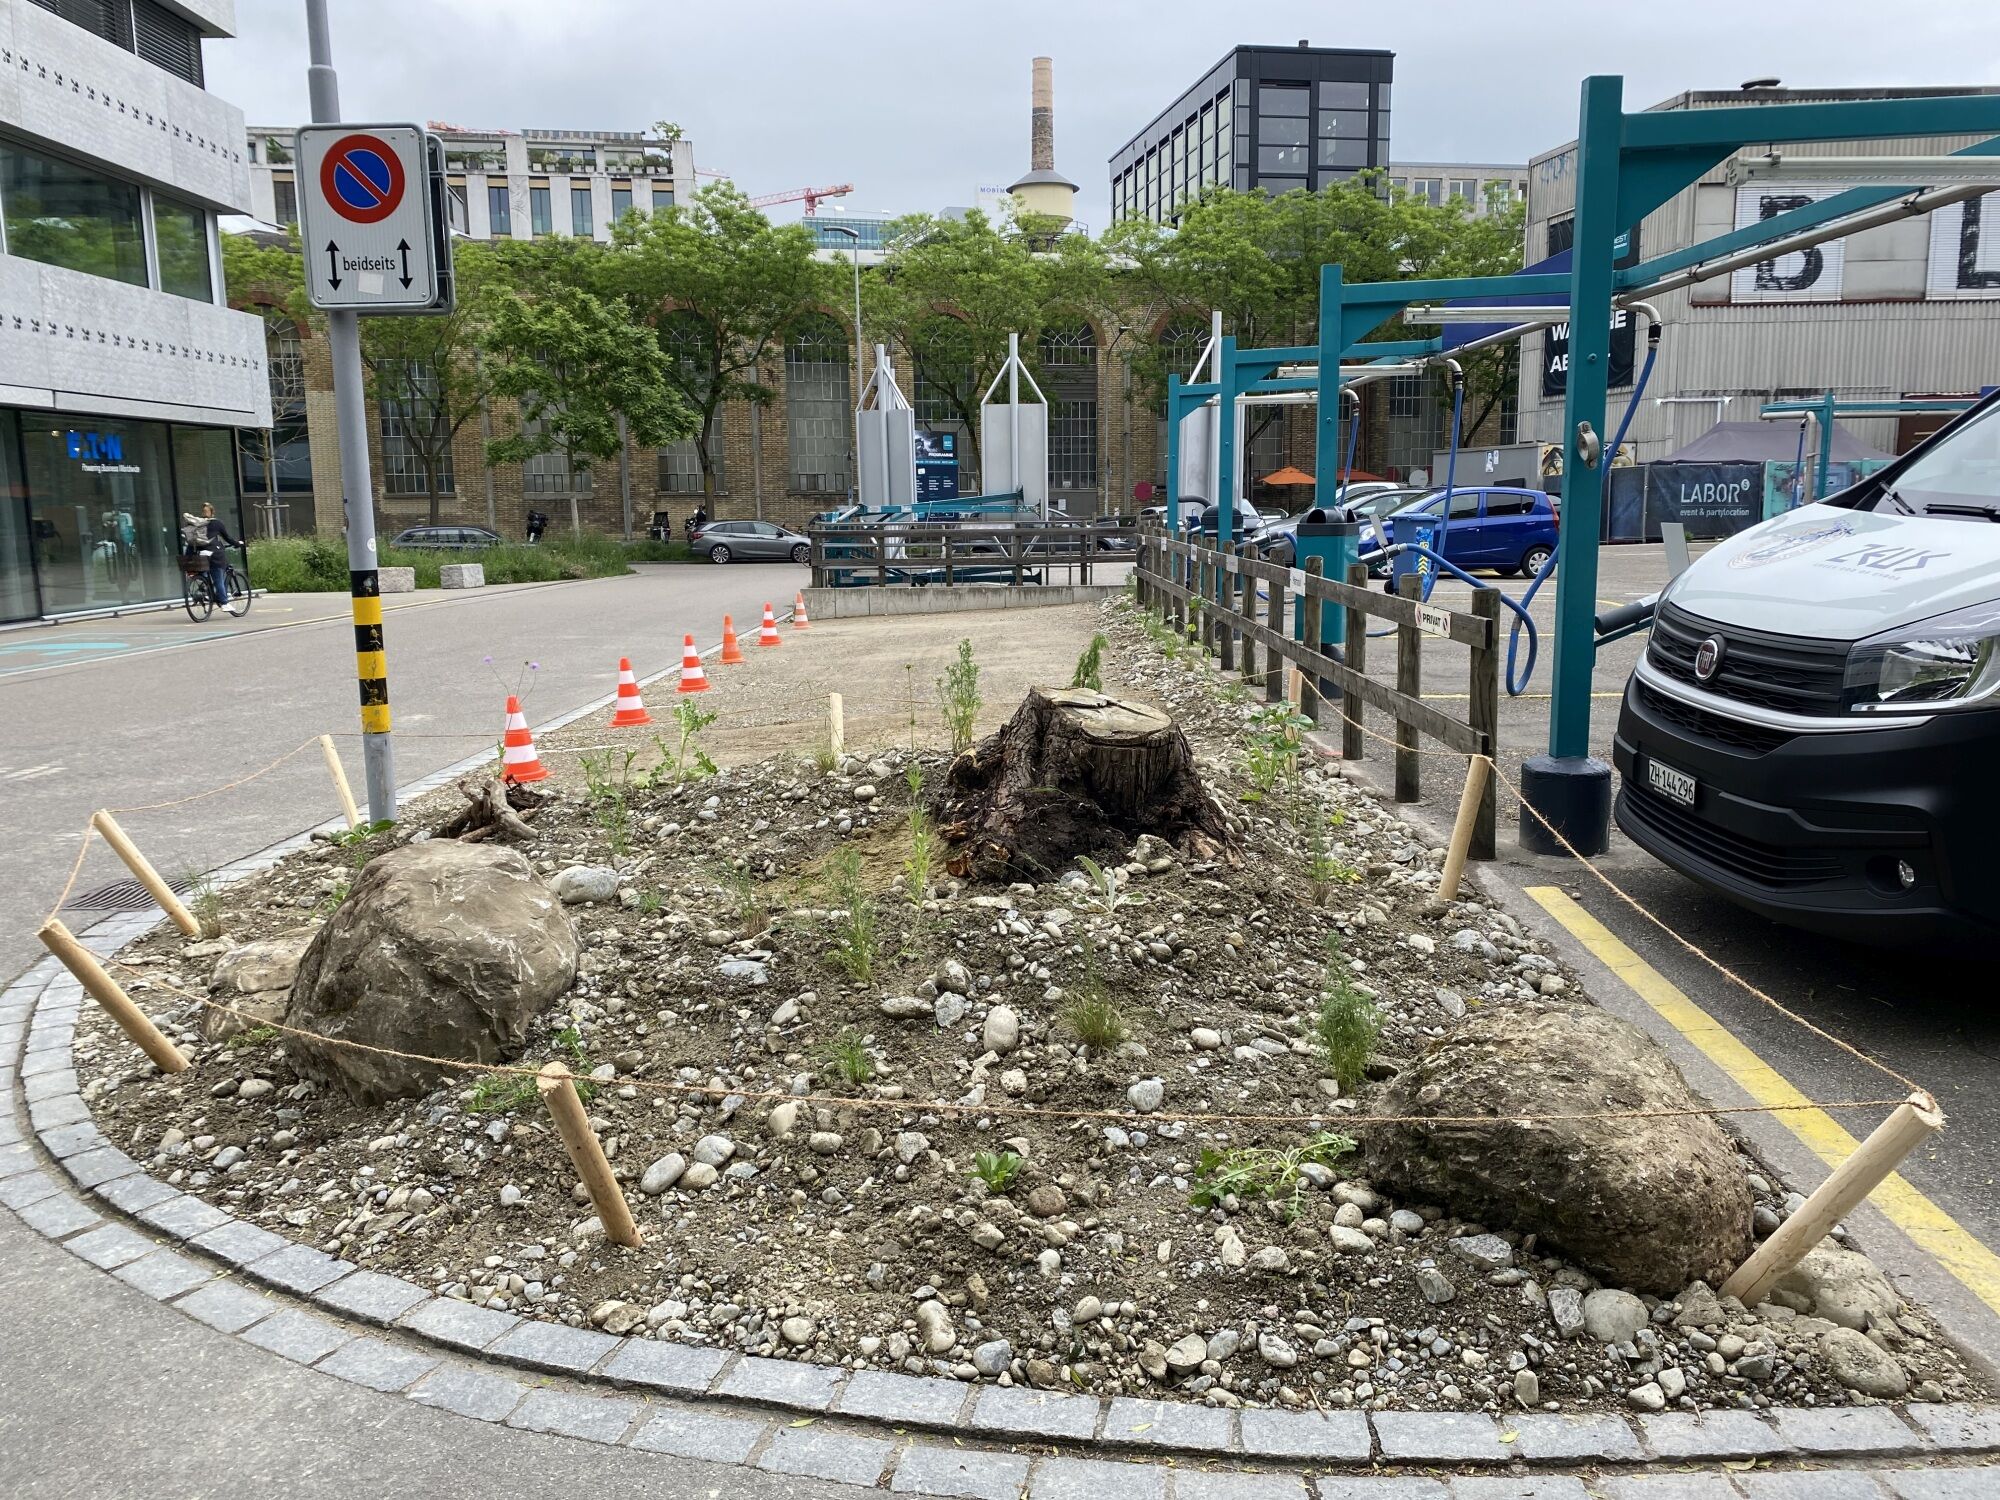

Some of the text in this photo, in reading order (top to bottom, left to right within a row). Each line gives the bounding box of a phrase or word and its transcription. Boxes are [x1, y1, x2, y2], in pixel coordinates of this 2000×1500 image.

[343, 256, 396, 271] beidseits
[1700, 508, 1705, 516] &
[1706, 508, 1749, 518] partylocation
[1422, 613, 1441, 627] PRIVAT
[1698, 650, 1713, 669] FIAT
